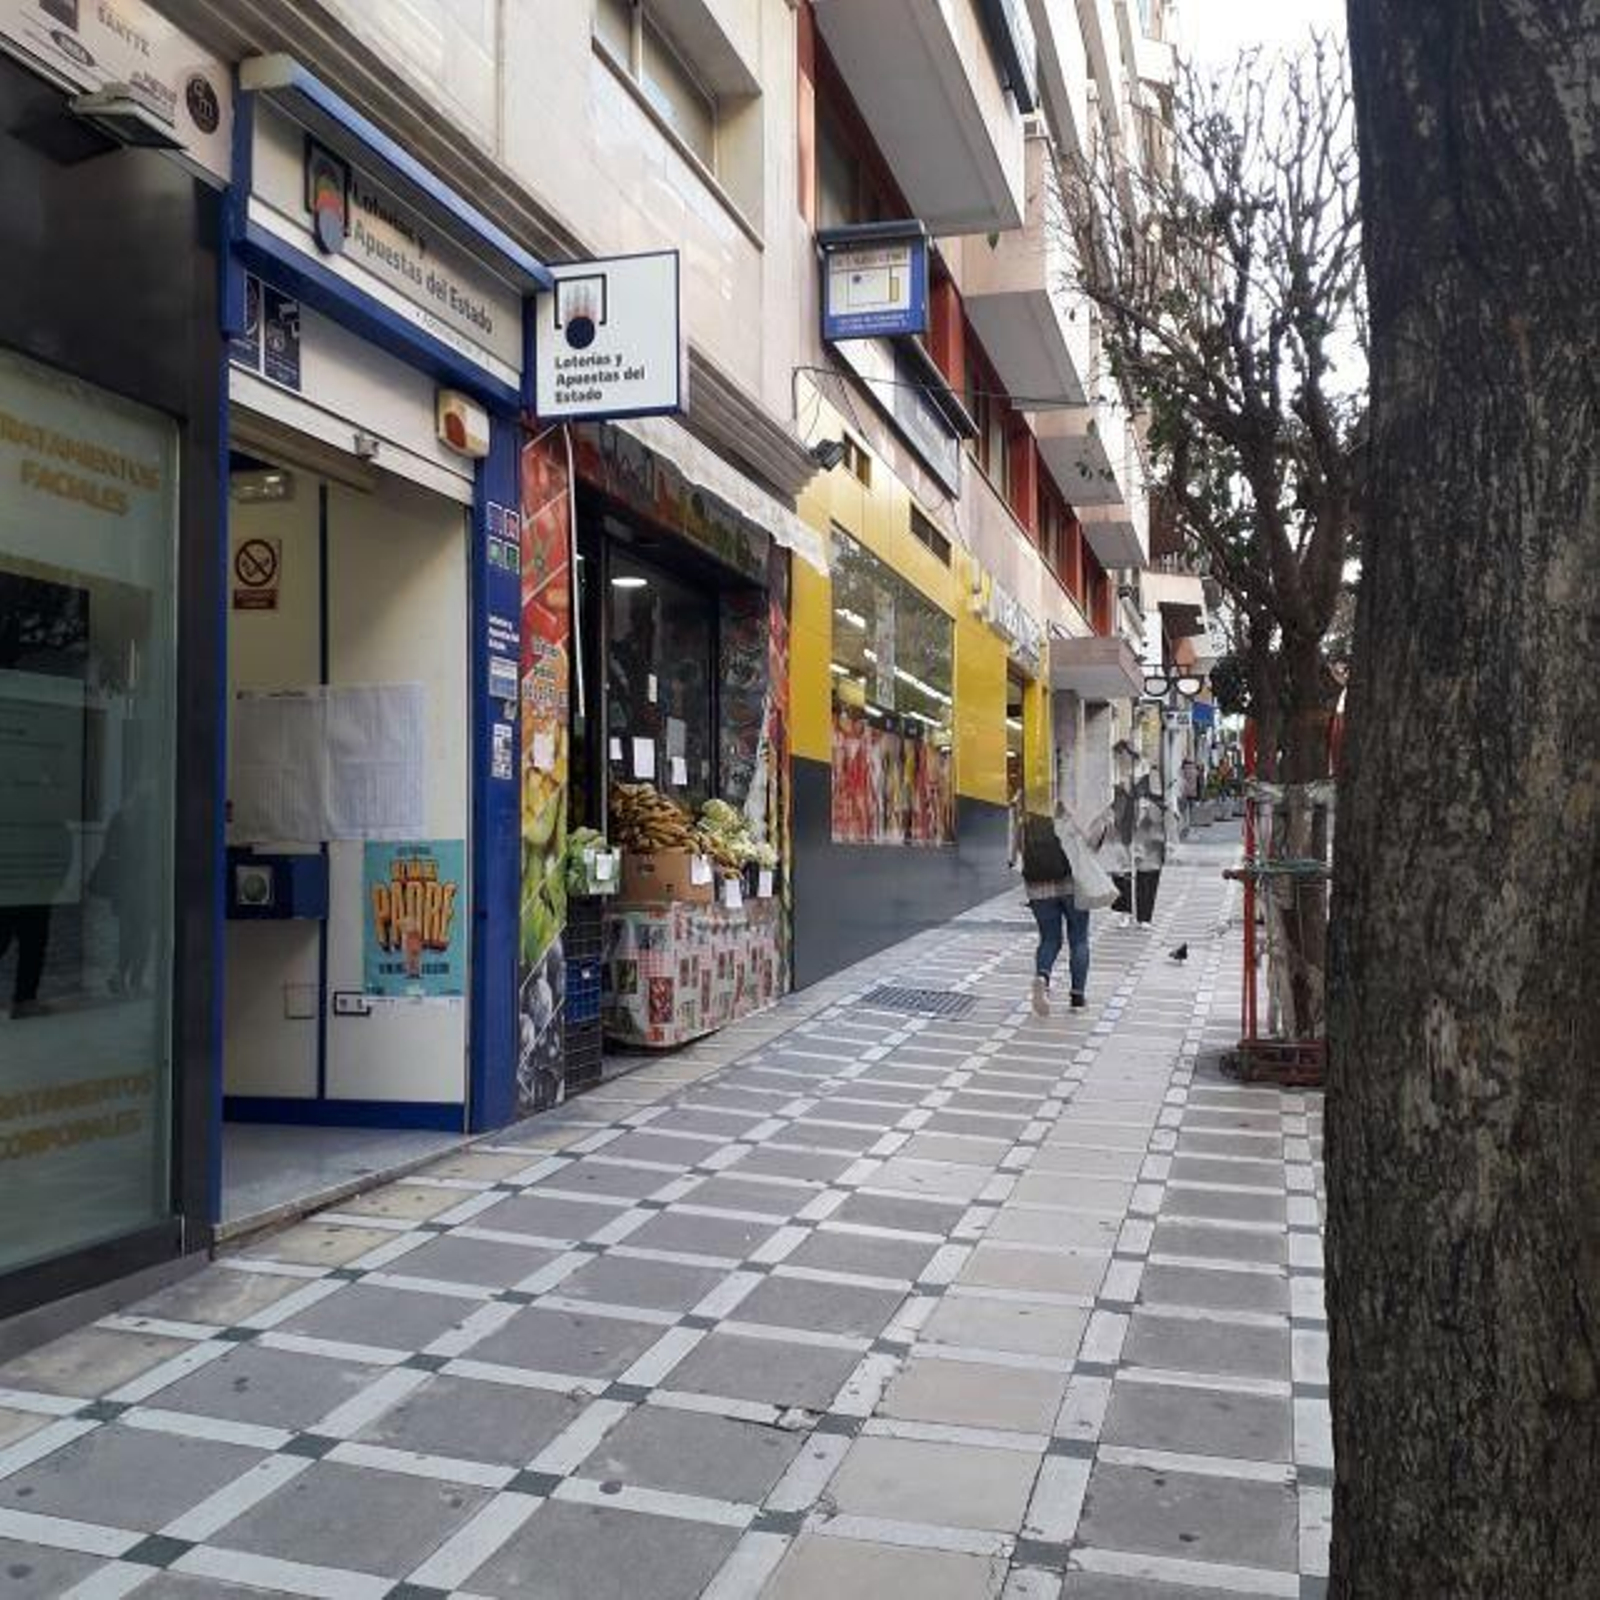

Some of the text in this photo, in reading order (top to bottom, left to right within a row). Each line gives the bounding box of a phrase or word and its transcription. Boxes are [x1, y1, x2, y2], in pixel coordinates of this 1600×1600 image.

[354, 219, 493, 335] Apuestas del Estado
[555, 389, 602, 403] Estado
[556, 366, 645, 388] Apuestas del
[372, 880, 457, 948] PADRE
